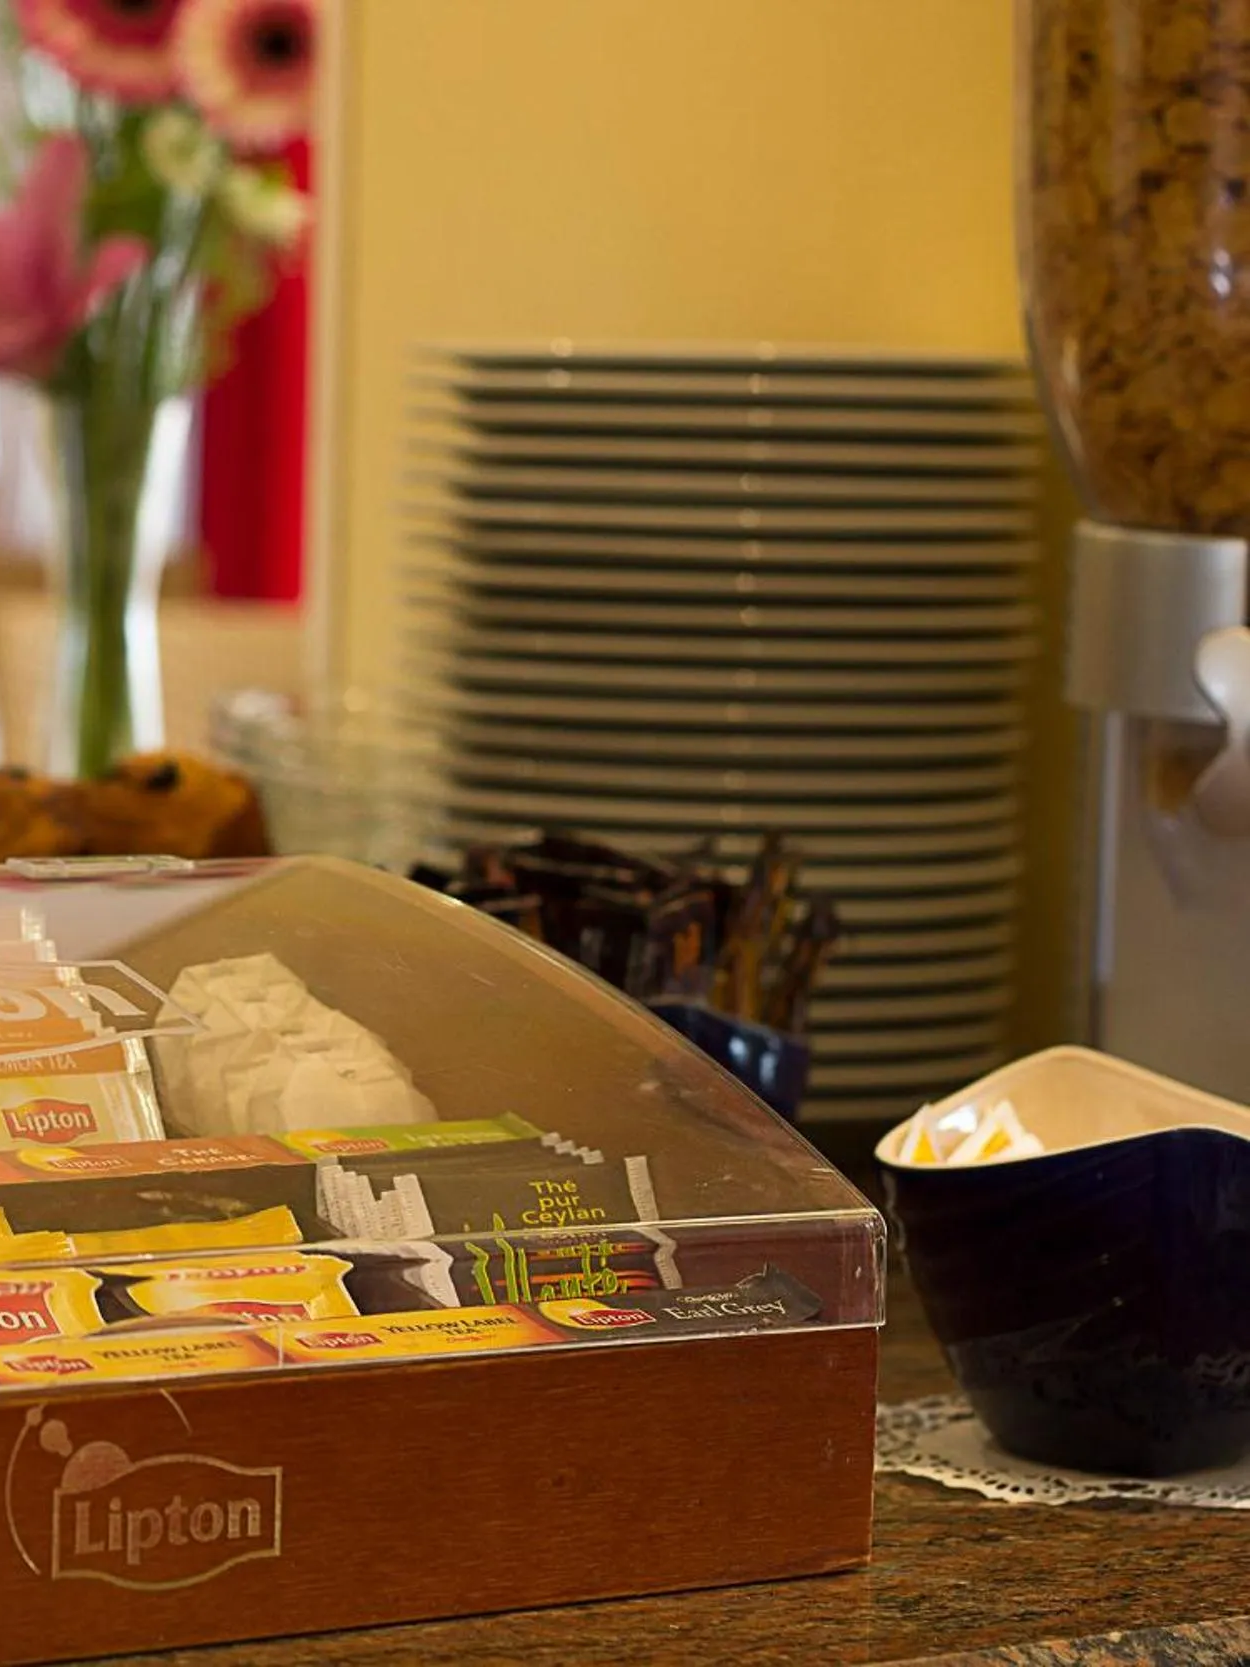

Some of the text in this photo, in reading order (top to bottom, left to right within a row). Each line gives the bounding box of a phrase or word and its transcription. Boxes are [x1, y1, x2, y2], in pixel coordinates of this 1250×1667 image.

[49, 1053, 78, 1071] TEA
[9, 1108, 91, 1139] Lipton
[528, 1178, 578, 1195] Thé
[537, 1192, 581, 1211] pur
[521, 1207, 606, 1227] Ceylan
[576, 1309, 649, 1326] Lipton
[664, 1299, 788, 1321] Earl Grey
[381, 1315, 518, 1335] YELLOW LABEL
[300, 1333, 376, 1349] Lipton
[7, 1356, 88, 1374] Lipton
[74, 1495, 261, 1566] Lipton
